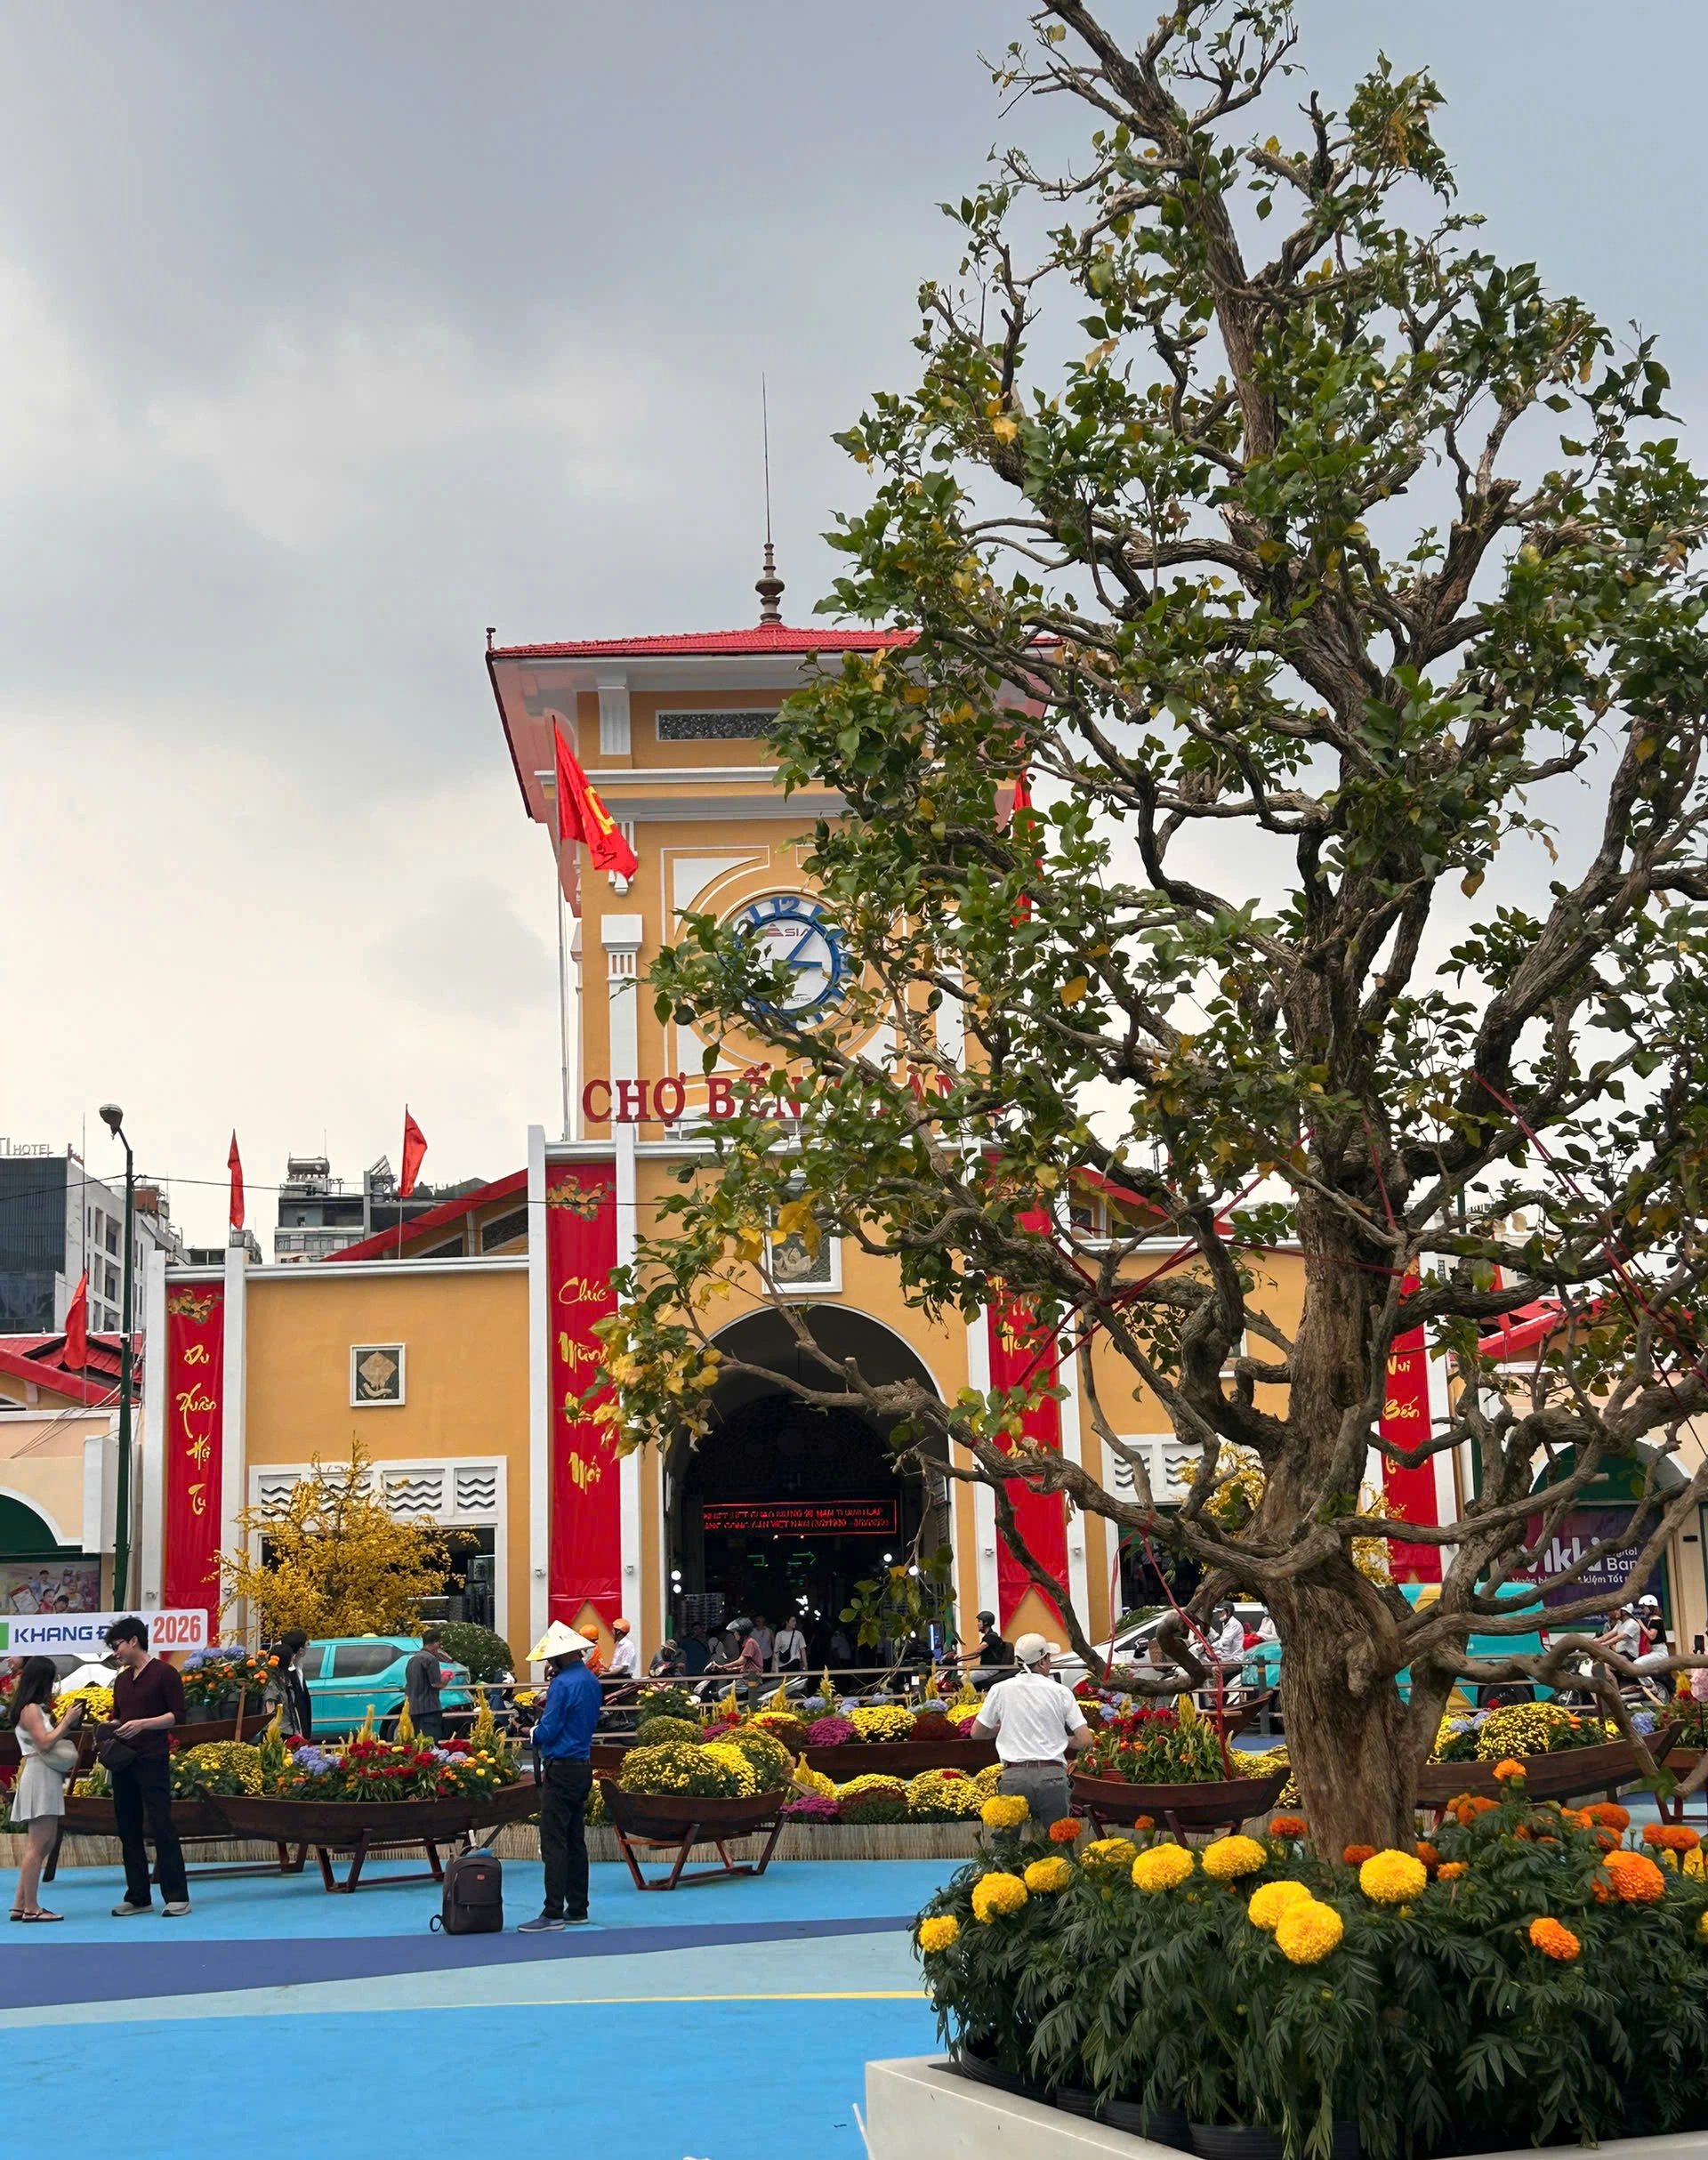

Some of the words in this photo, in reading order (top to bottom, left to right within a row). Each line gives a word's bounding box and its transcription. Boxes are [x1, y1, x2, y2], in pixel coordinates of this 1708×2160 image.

[770, 896, 800, 918] 12
[582, 1072, 686, 1127] CHỢ
[13, 1144, 54, 1156] HOTEL
[559, 1277, 608, 1304] Chúc
[1382, 1396, 1420, 1421] Bến
[568, 1452, 601, 1495] Mới
[1607, 1558, 1638, 1572] Ban
[14, 1626, 93, 1643] KHANG
[152, 1615, 201, 1644] 2026
